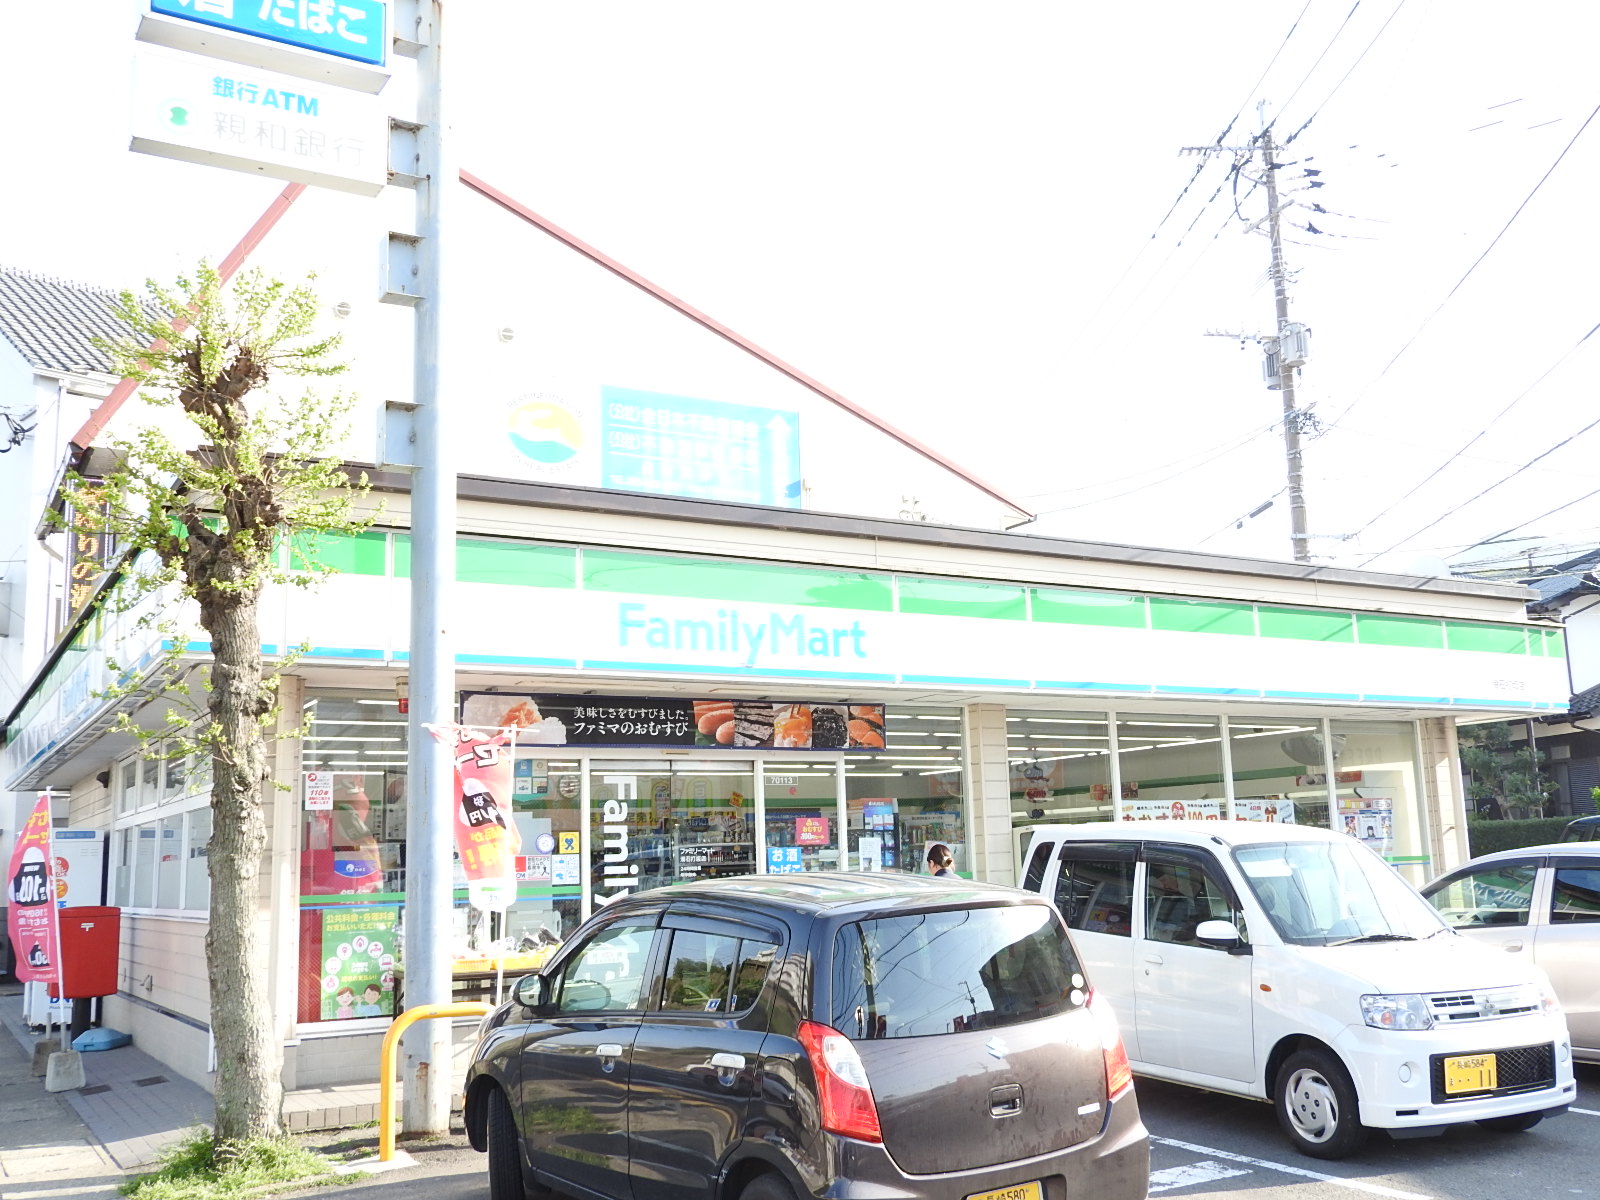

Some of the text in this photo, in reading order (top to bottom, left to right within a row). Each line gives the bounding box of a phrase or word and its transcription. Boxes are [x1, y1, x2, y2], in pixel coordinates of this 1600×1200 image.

[211, 75, 319, 117] 銀行ATM
[213, 110, 364, 168] 親和銀行
[618, 602, 868, 667] FamilyMart
[573, 706, 691, 721] 美味しさをむすびました。
[573, 720, 690, 738] ファミマのおむすび
[770, 776, 793, 784] 70113
[680, 847, 716, 855] ファミリーマート
[772, 849, 798, 862] お酒
